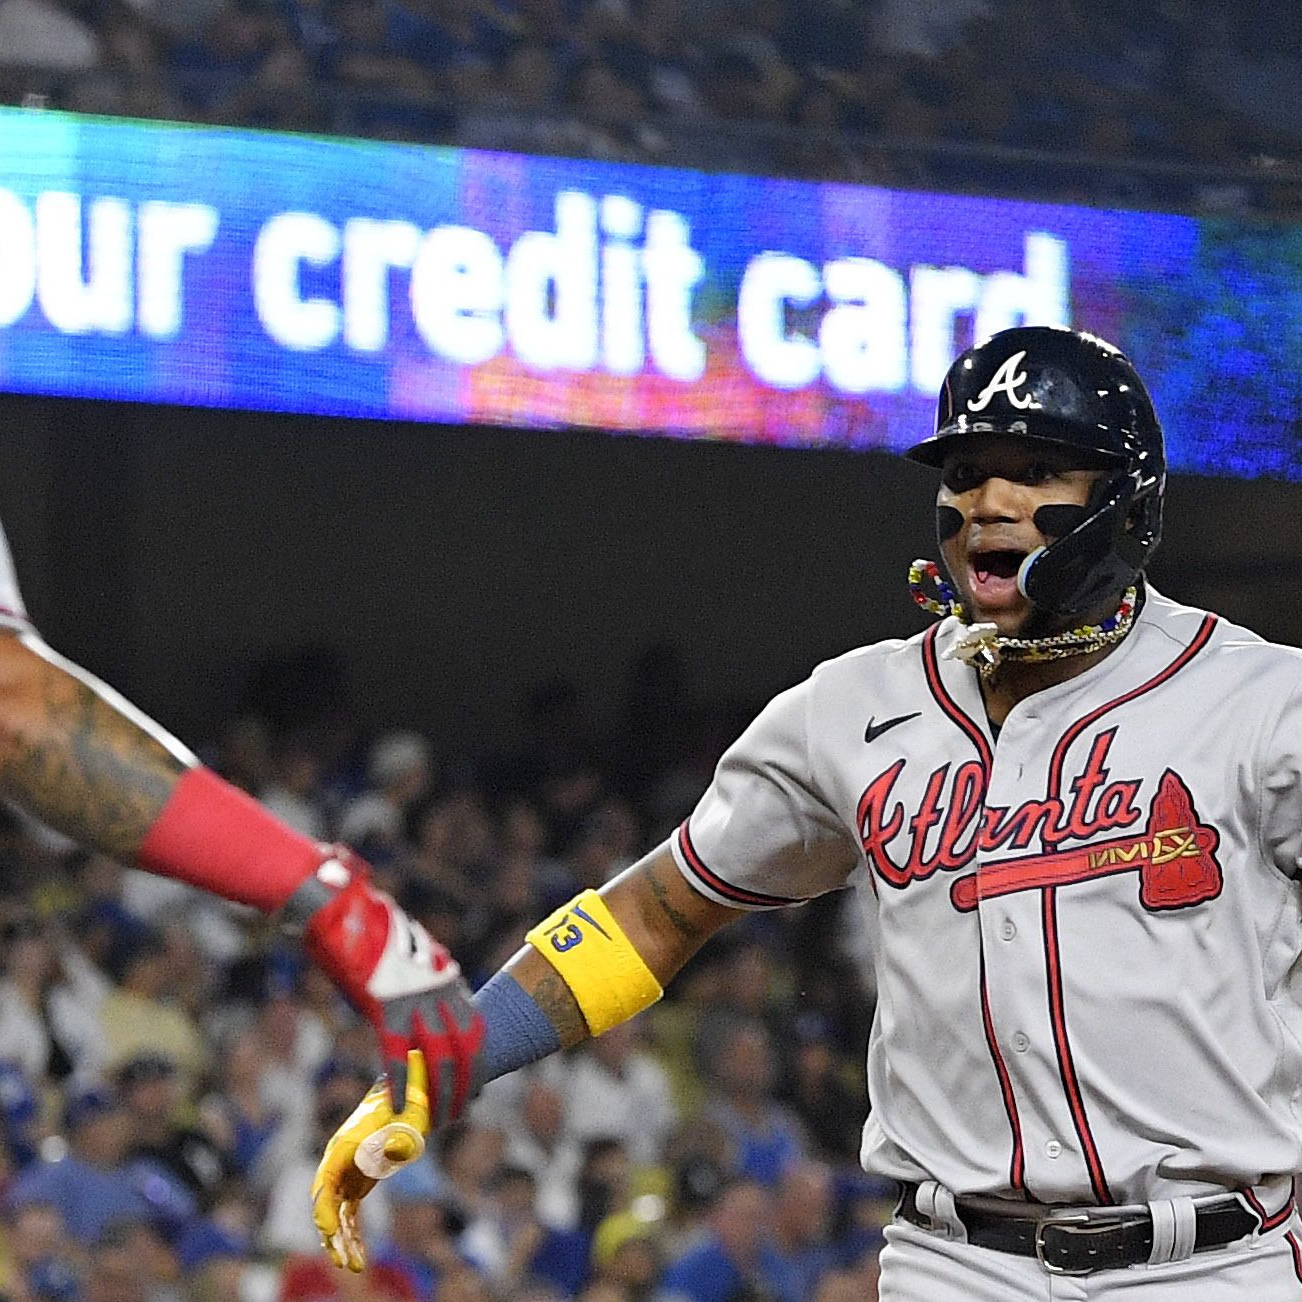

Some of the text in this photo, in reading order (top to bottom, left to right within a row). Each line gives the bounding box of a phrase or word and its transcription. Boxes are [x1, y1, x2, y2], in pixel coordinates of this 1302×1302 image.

[251, 190, 709, 383] credit
[966, 350, 1032, 412] A
[855, 724, 1145, 890] Atlanta
